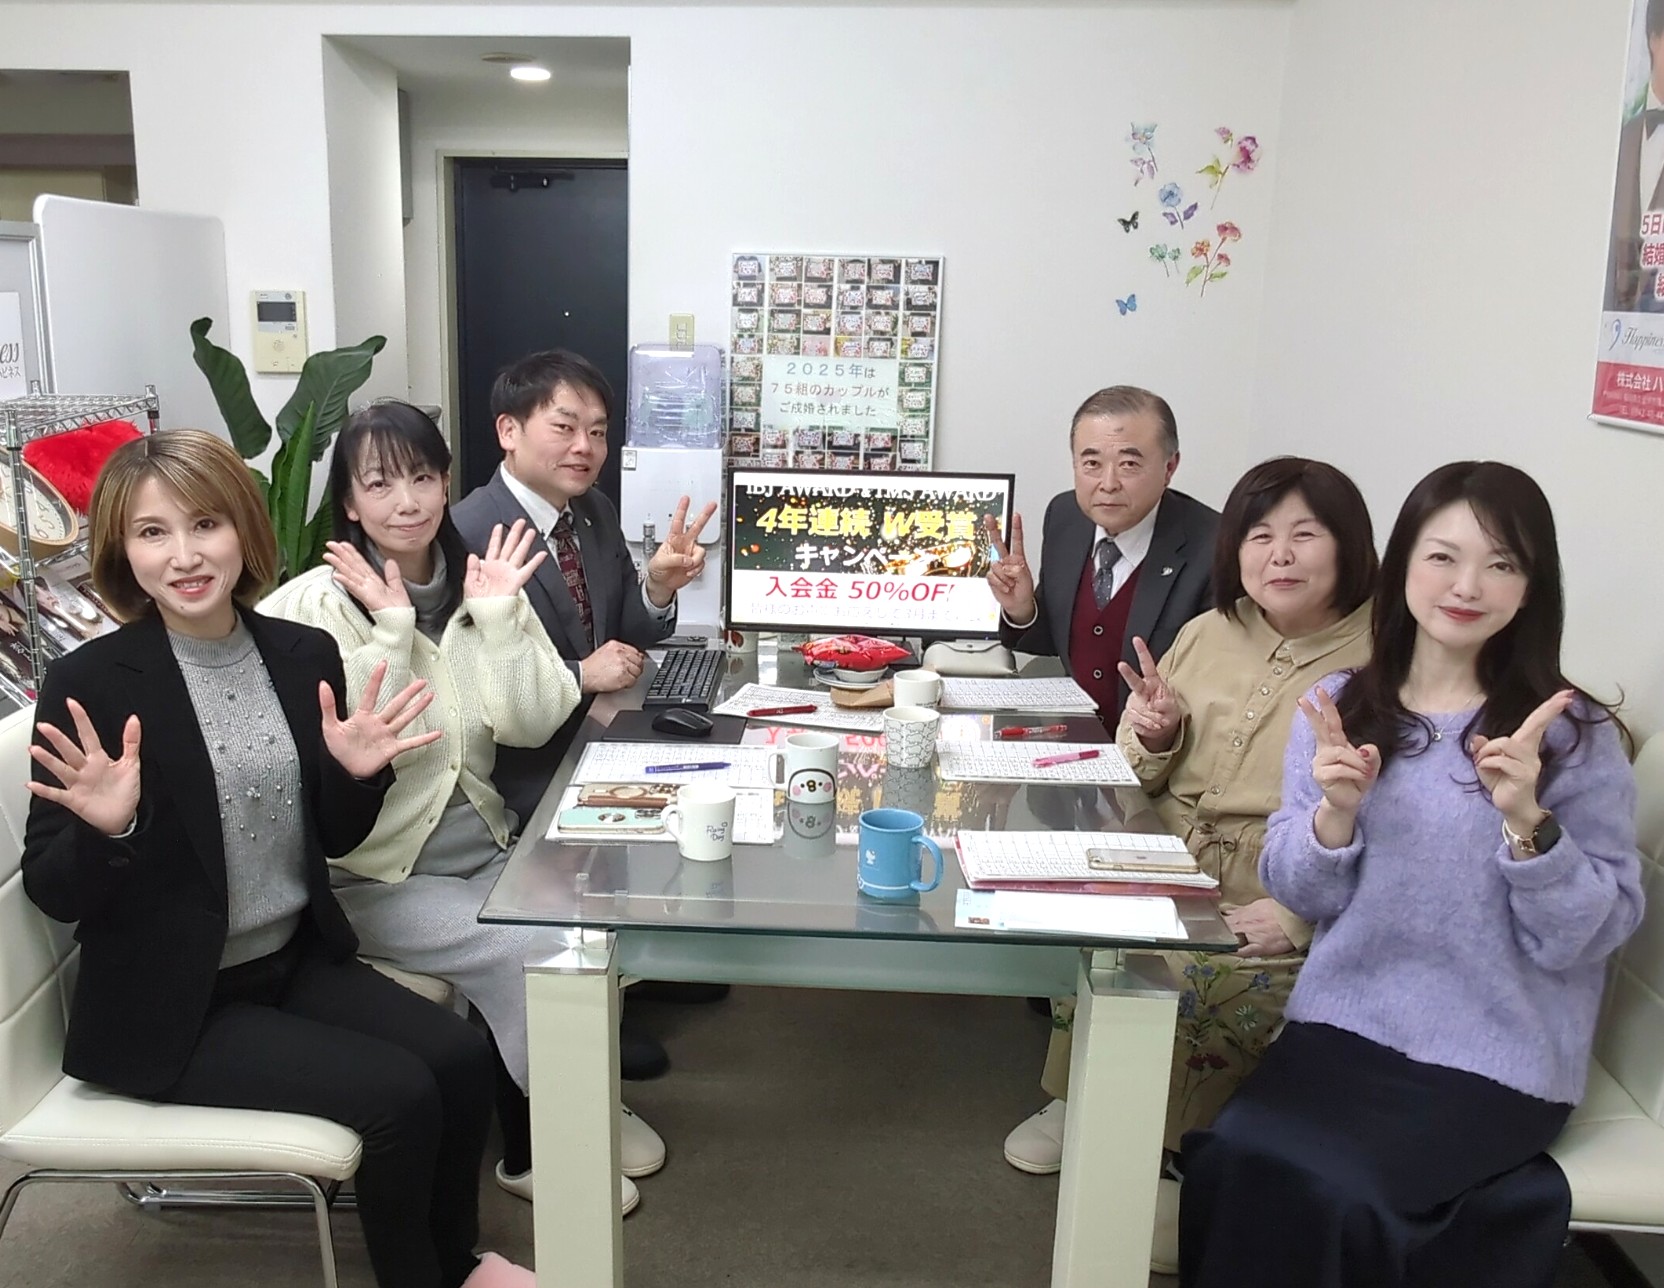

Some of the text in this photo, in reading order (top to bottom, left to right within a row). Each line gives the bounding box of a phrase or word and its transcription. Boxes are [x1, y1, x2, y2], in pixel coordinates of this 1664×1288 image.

[786, 361, 876, 379] 2025年は
[779, 402, 876, 417] ご成婚されました
[756, 503, 978, 541] 4年連続 W受賞
[765, 576, 838, 600] 入会金
